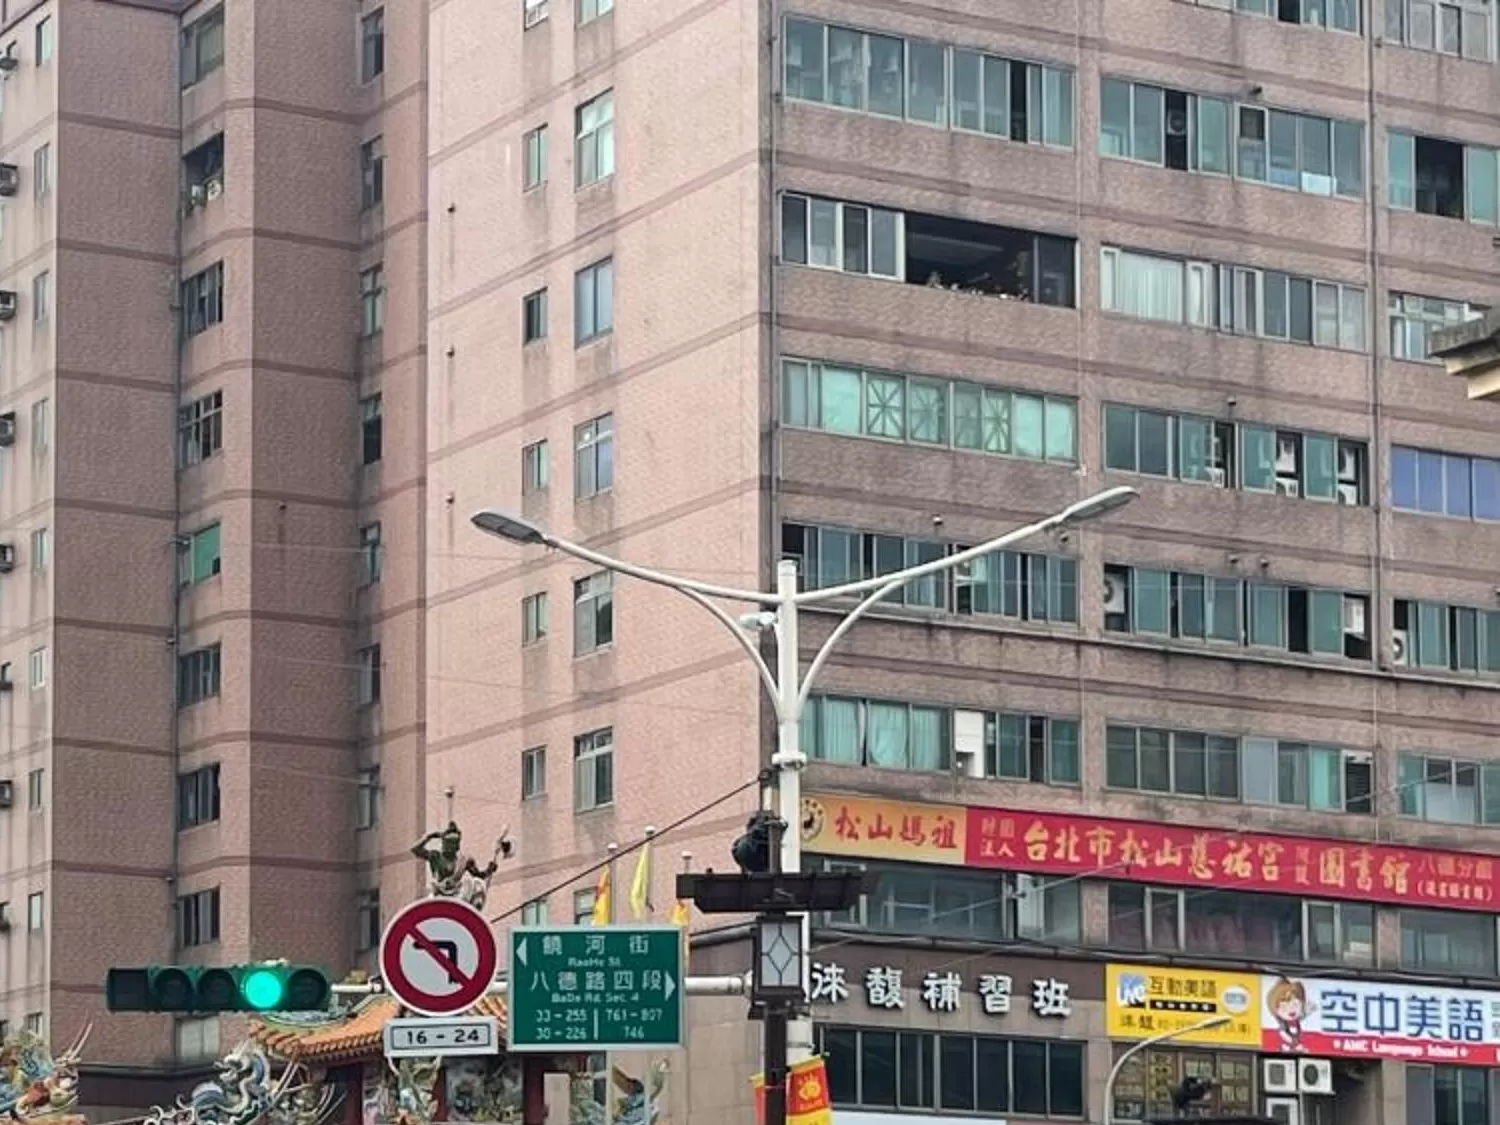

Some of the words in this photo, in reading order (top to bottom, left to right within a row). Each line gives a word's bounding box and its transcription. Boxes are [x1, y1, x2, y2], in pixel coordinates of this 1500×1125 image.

[835, 806, 957, 849] 松山媽祖
[542, 934, 649, 956] 饒河街
[530, 969, 662, 992] 八德路四段
[1320, 989, 1484, 1041] 空中美語
